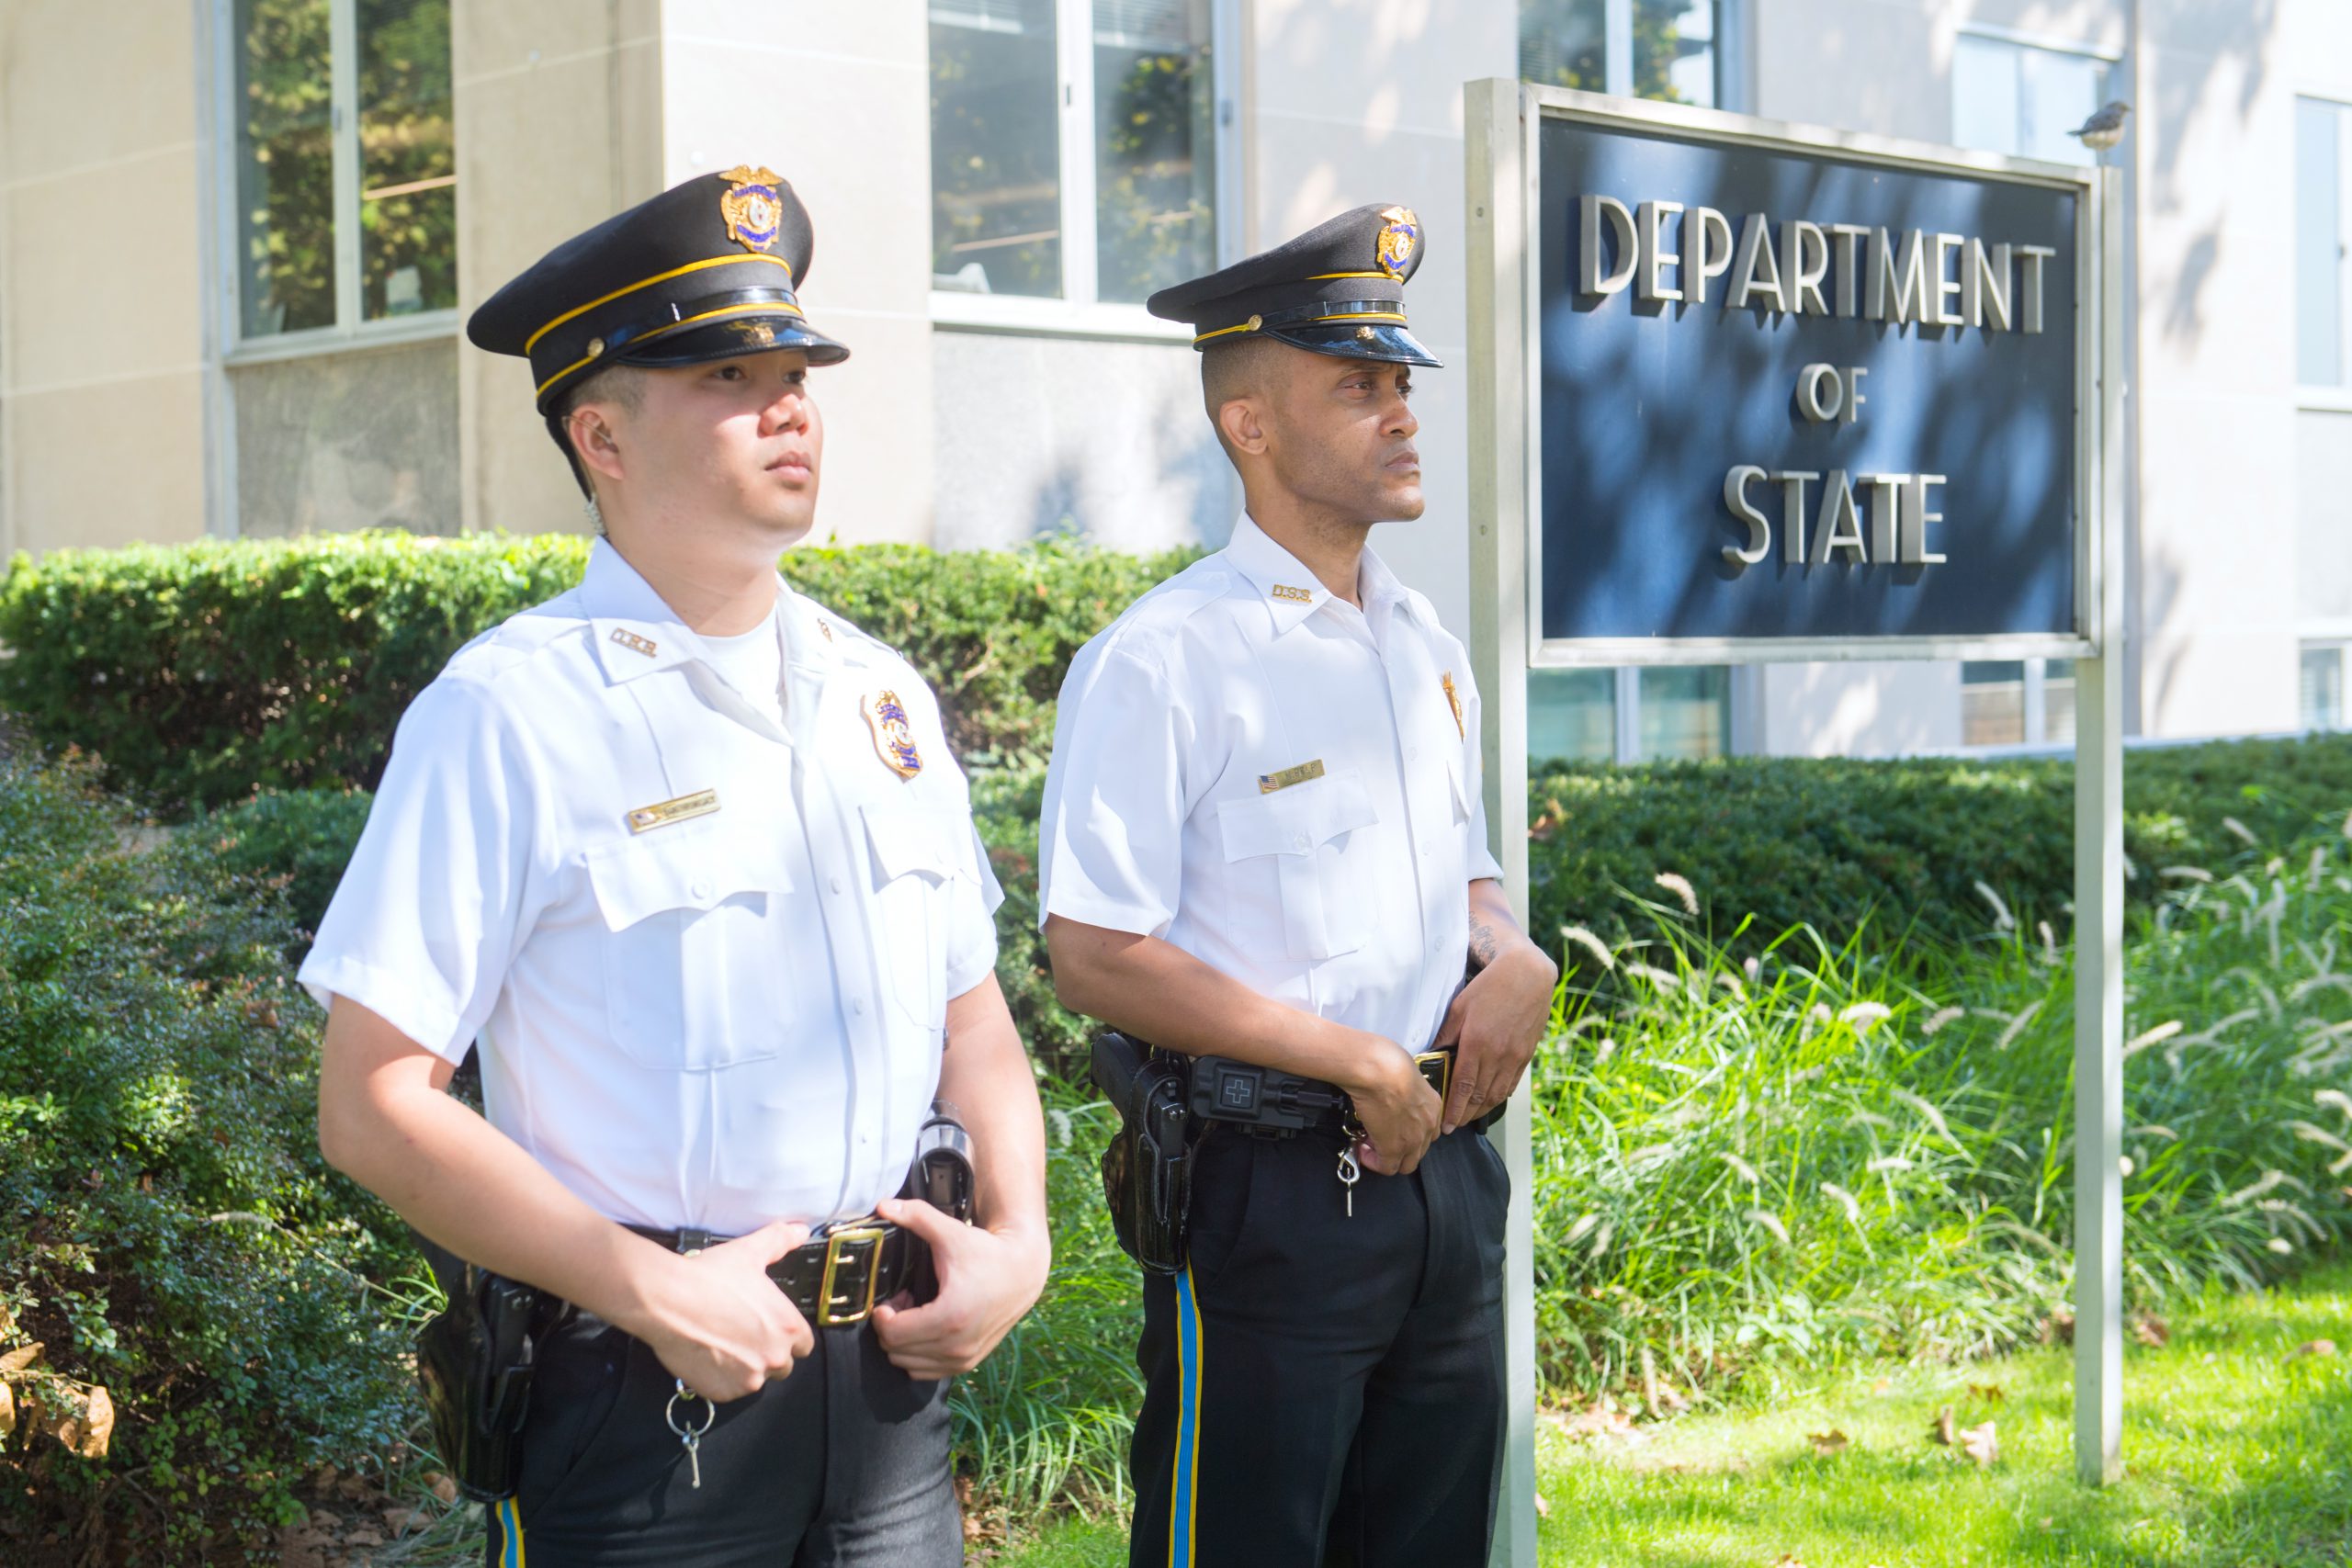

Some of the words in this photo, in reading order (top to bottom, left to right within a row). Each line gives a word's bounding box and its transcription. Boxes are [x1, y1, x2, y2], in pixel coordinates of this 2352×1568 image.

[1580, 195, 2056, 334] DEPARTMENT
[1796, 363, 1869, 423] OF
[1721, 465, 1948, 564] STATE
